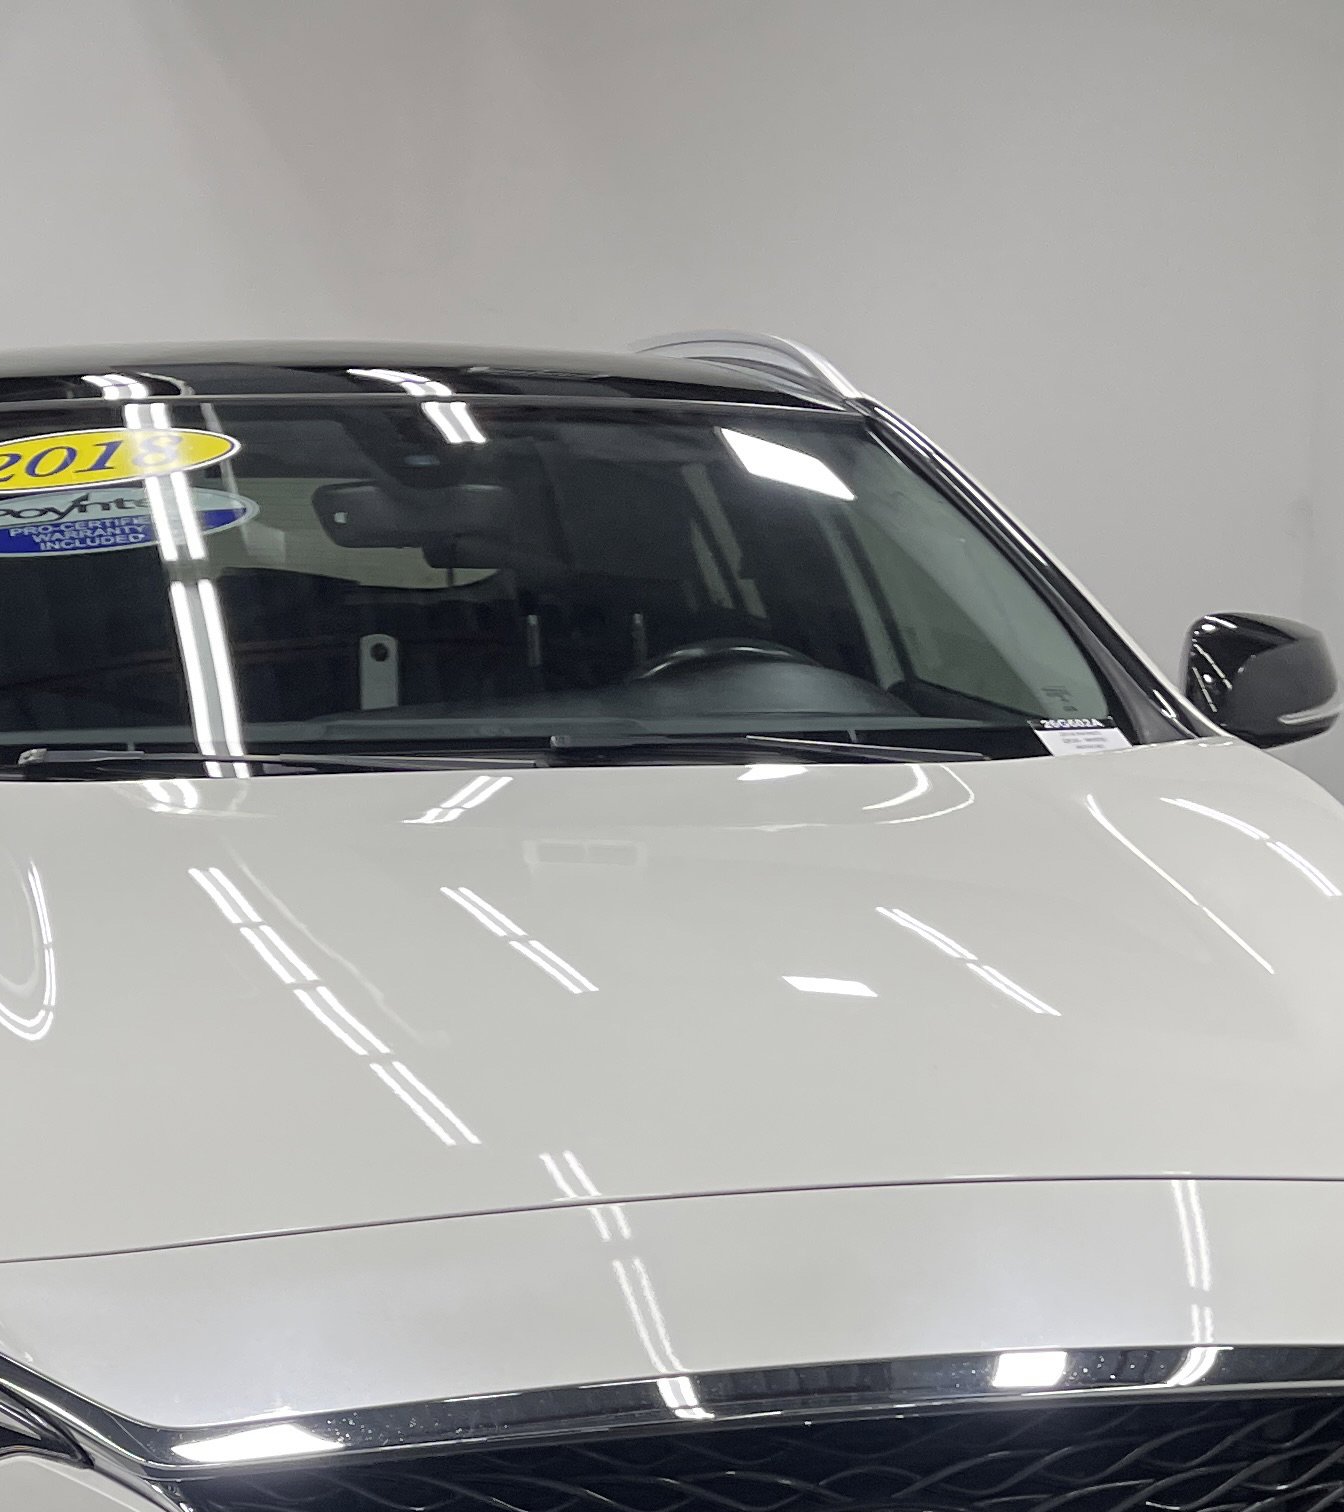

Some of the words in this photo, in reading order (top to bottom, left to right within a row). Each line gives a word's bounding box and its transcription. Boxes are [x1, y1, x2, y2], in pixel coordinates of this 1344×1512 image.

[9, 515, 157, 538] PRO-CERTIFIE
[31, 524, 146, 544] WARRANTY
[40, 533, 146, 551] INCLUDED
